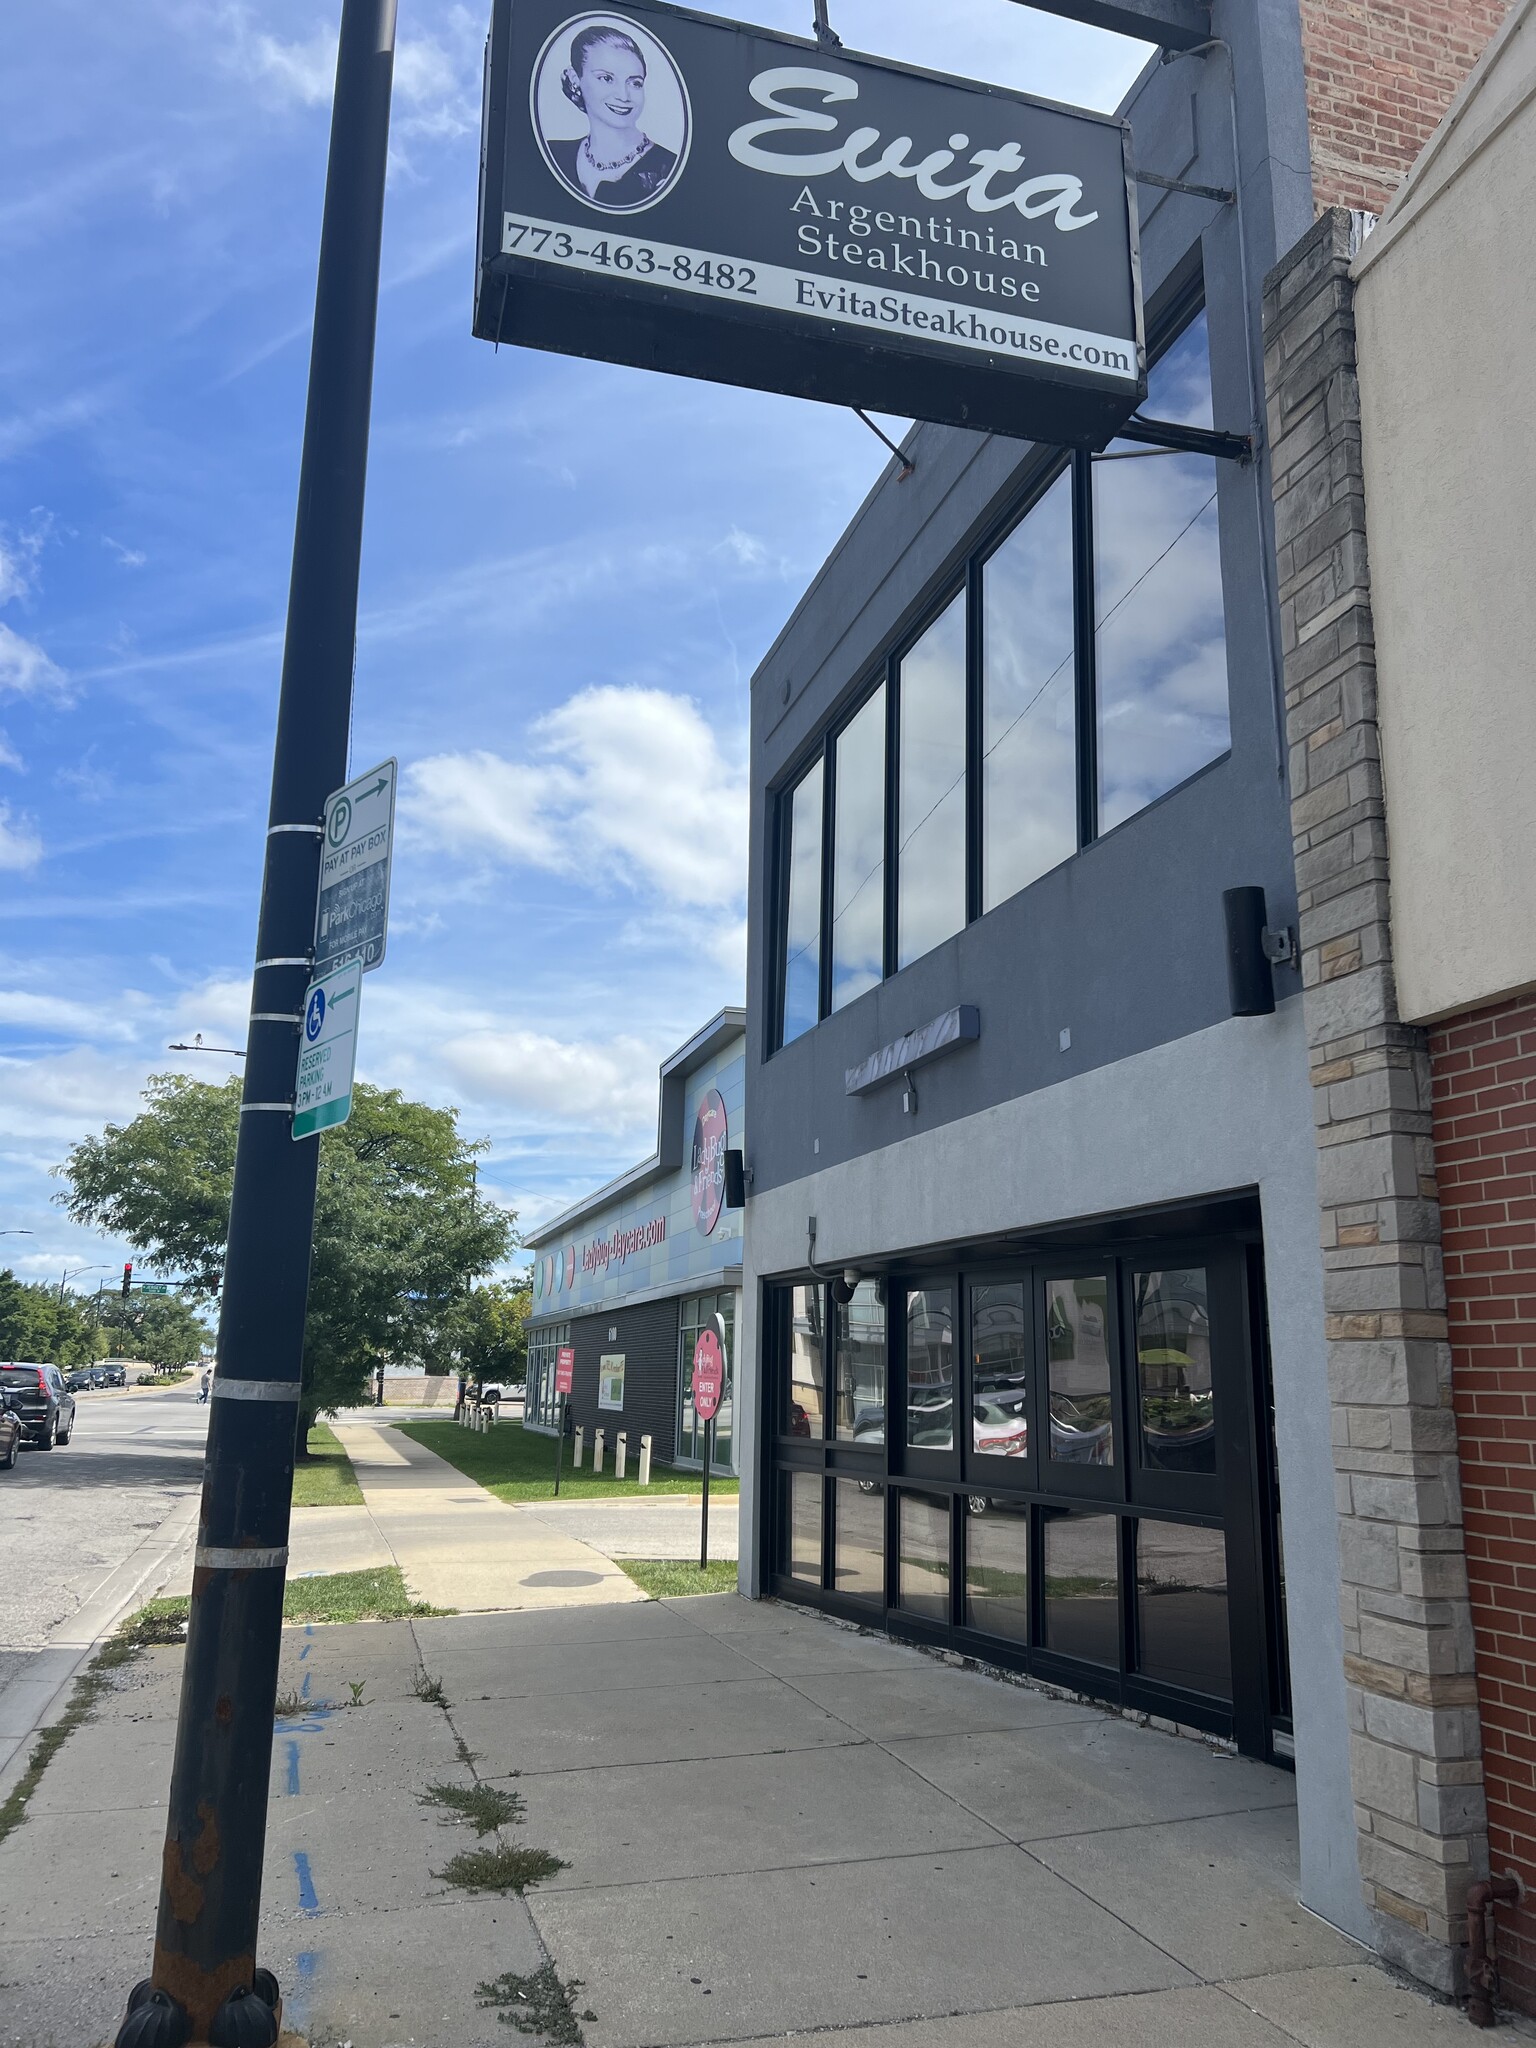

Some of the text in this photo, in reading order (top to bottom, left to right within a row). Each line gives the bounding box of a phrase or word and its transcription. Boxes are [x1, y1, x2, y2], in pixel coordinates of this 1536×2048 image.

[728, 67, 1098, 231] Evita
[789, 187, 1048, 268] Argentinian
[507, 223, 758, 295] 773-463-8482
[797, 226, 1041, 302] Steakhouse
[795, 278, 1131, 372] EvitaSteakhouse.com
[325, 830, 386, 874] PAY AT PAY BOX
[299, 1066, 324, 1090] PARKING
[301, 1046, 331, 1073] RESERVED
[699, 1382, 714, 1393] ENTER
[700, 1396, 713, 1408] ONLY
